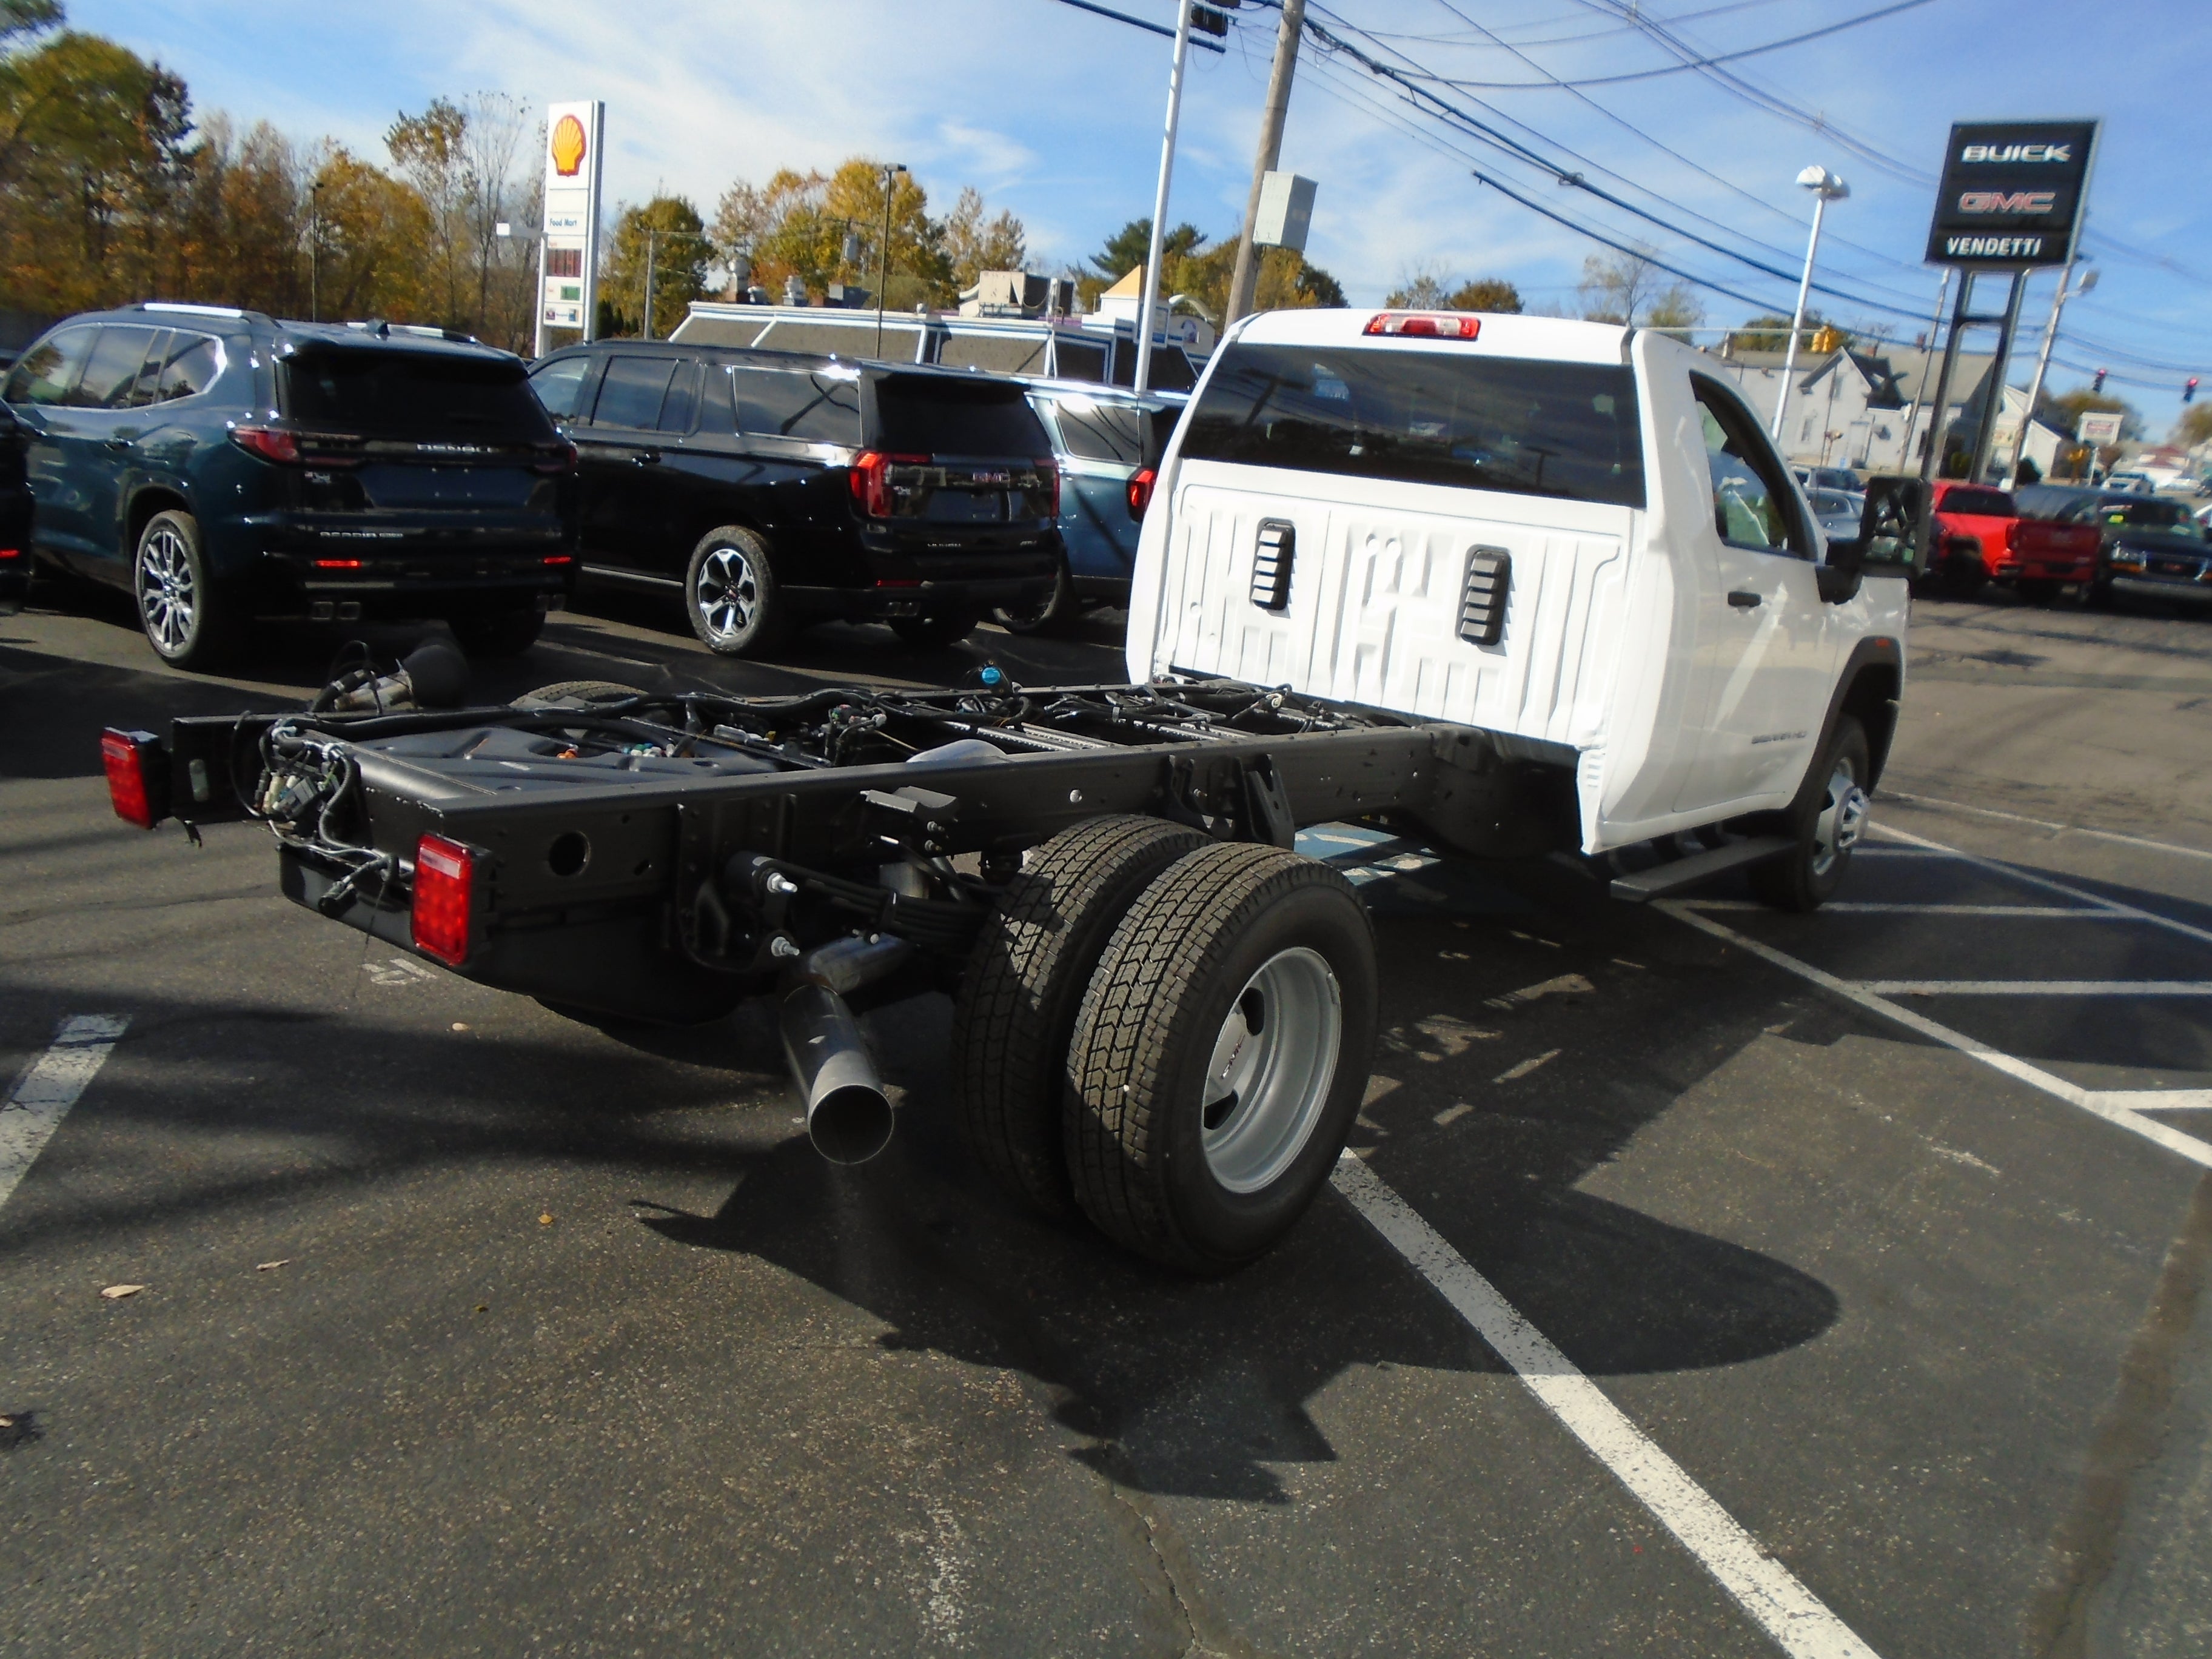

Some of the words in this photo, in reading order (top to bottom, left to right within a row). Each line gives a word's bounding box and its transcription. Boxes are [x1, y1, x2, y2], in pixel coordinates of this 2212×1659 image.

[1962, 145, 2071, 162] BUICK
[1959, 192, 2056, 212] GMC
[1947, 237, 2041, 256] VENDETTI
